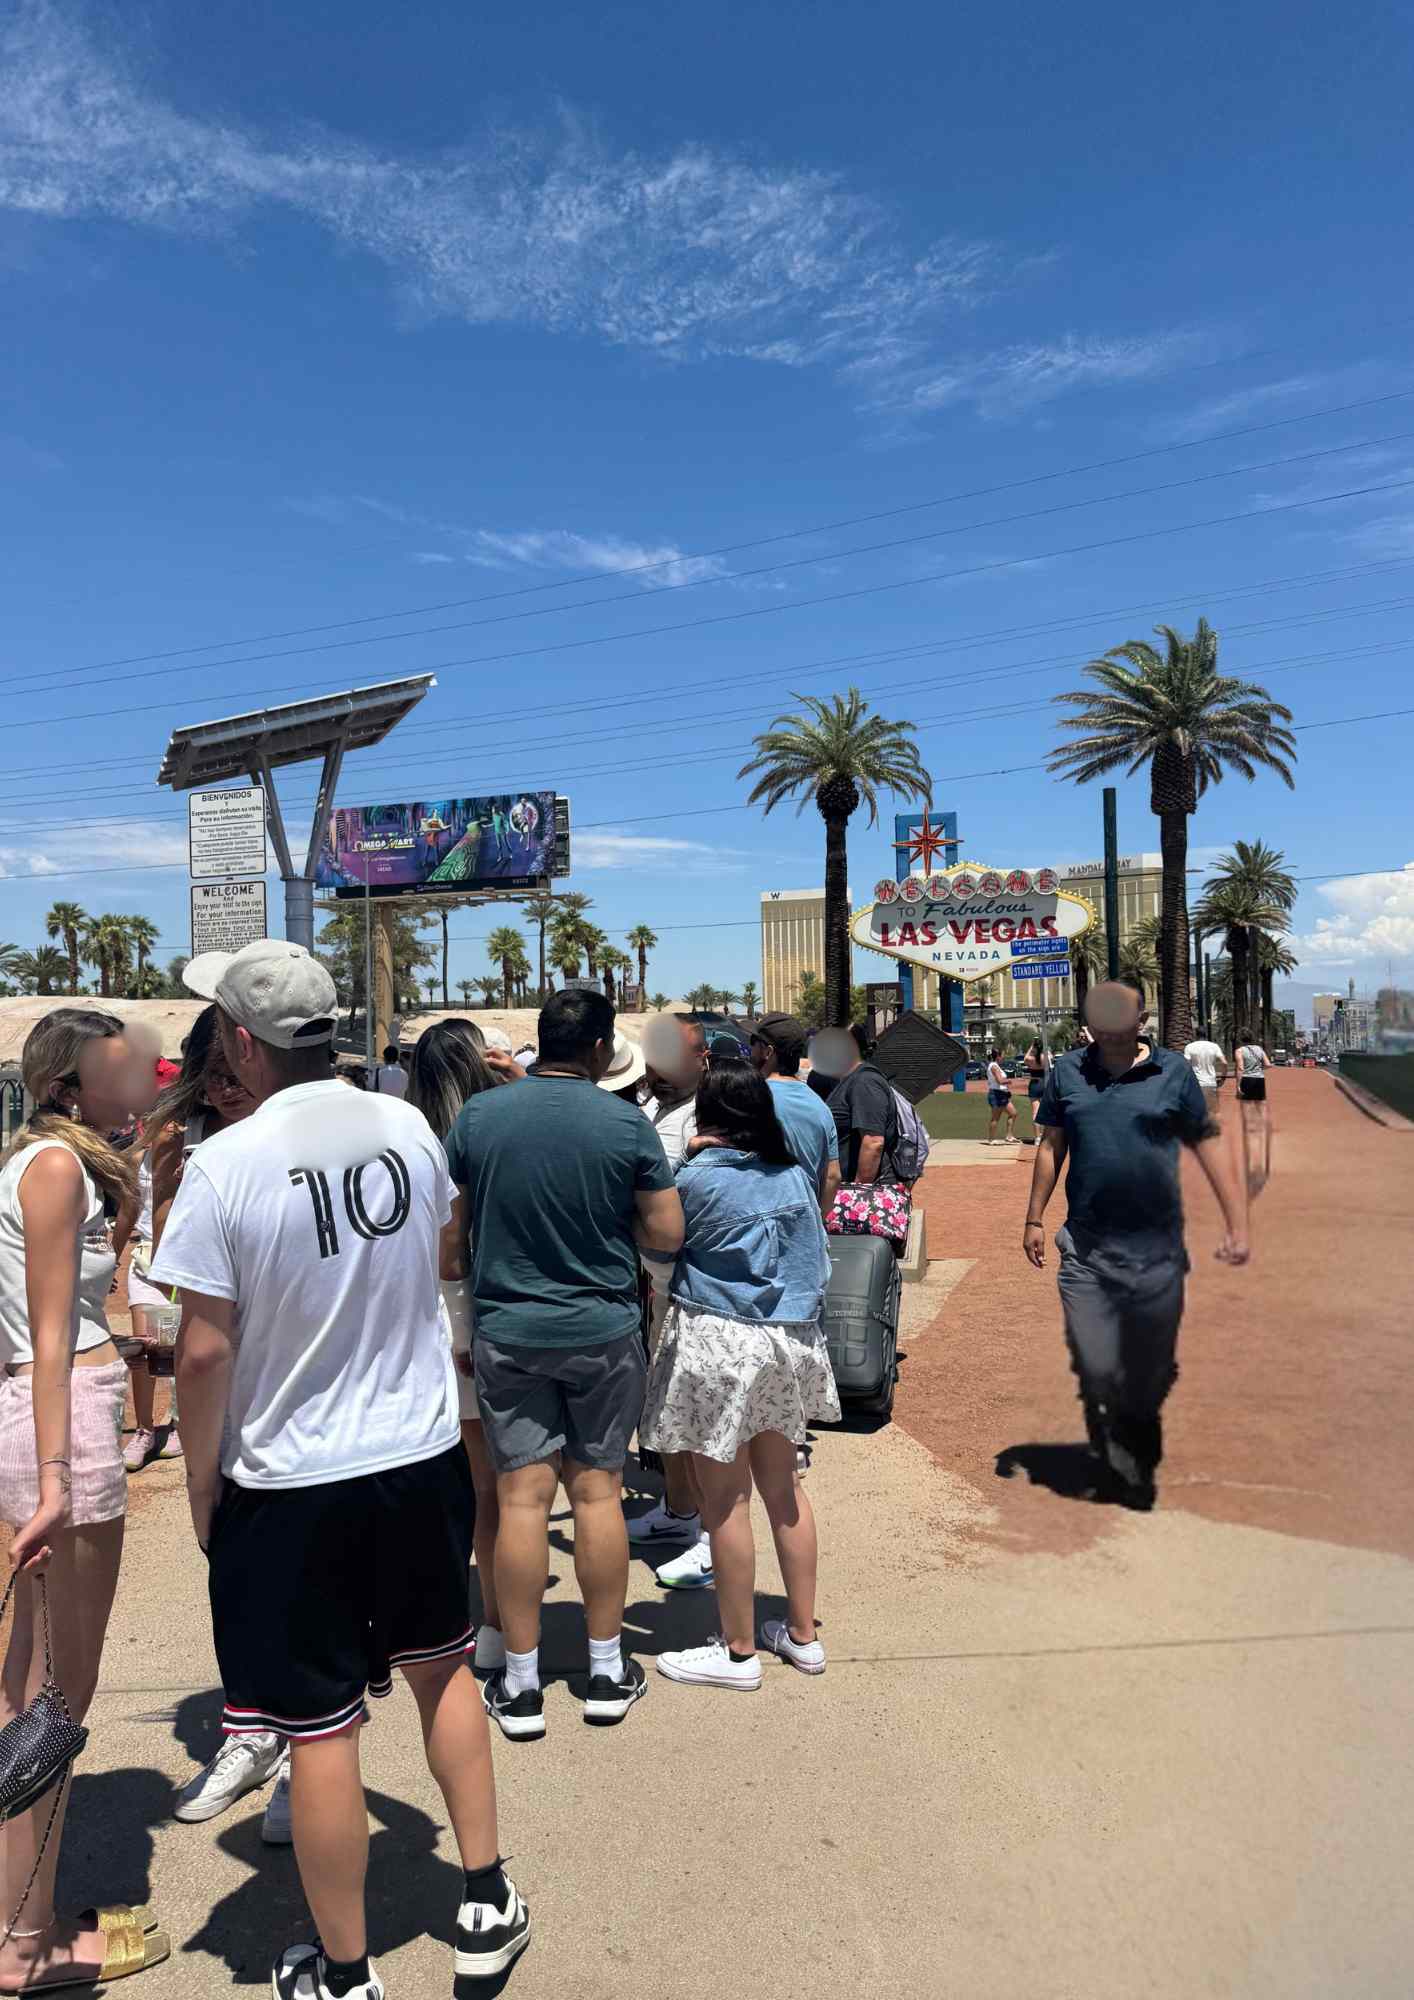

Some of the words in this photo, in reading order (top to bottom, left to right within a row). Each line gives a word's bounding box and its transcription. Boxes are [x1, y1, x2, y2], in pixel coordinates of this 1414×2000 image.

[202, 791, 252, 801] BIENVENIDOS
[354, 840, 386, 849] OMEGA
[203, 885, 254, 897] WELCOME
[874, 868, 1057, 903] WELCOME
[770, 892, 781, 900] W
[897, 906, 916, 919] TO
[923, 899, 1035, 919] Fabulous
[880, 920, 939, 947] LAS
[948, 916, 1059, 945] VEGAS
[932, 949, 1001, 961] NEVADA
[1013, 965, 1042, 977] STANDARD
[1046, 963, 1068, 975] YELLOW
[288, 1148, 411, 1259] 10
